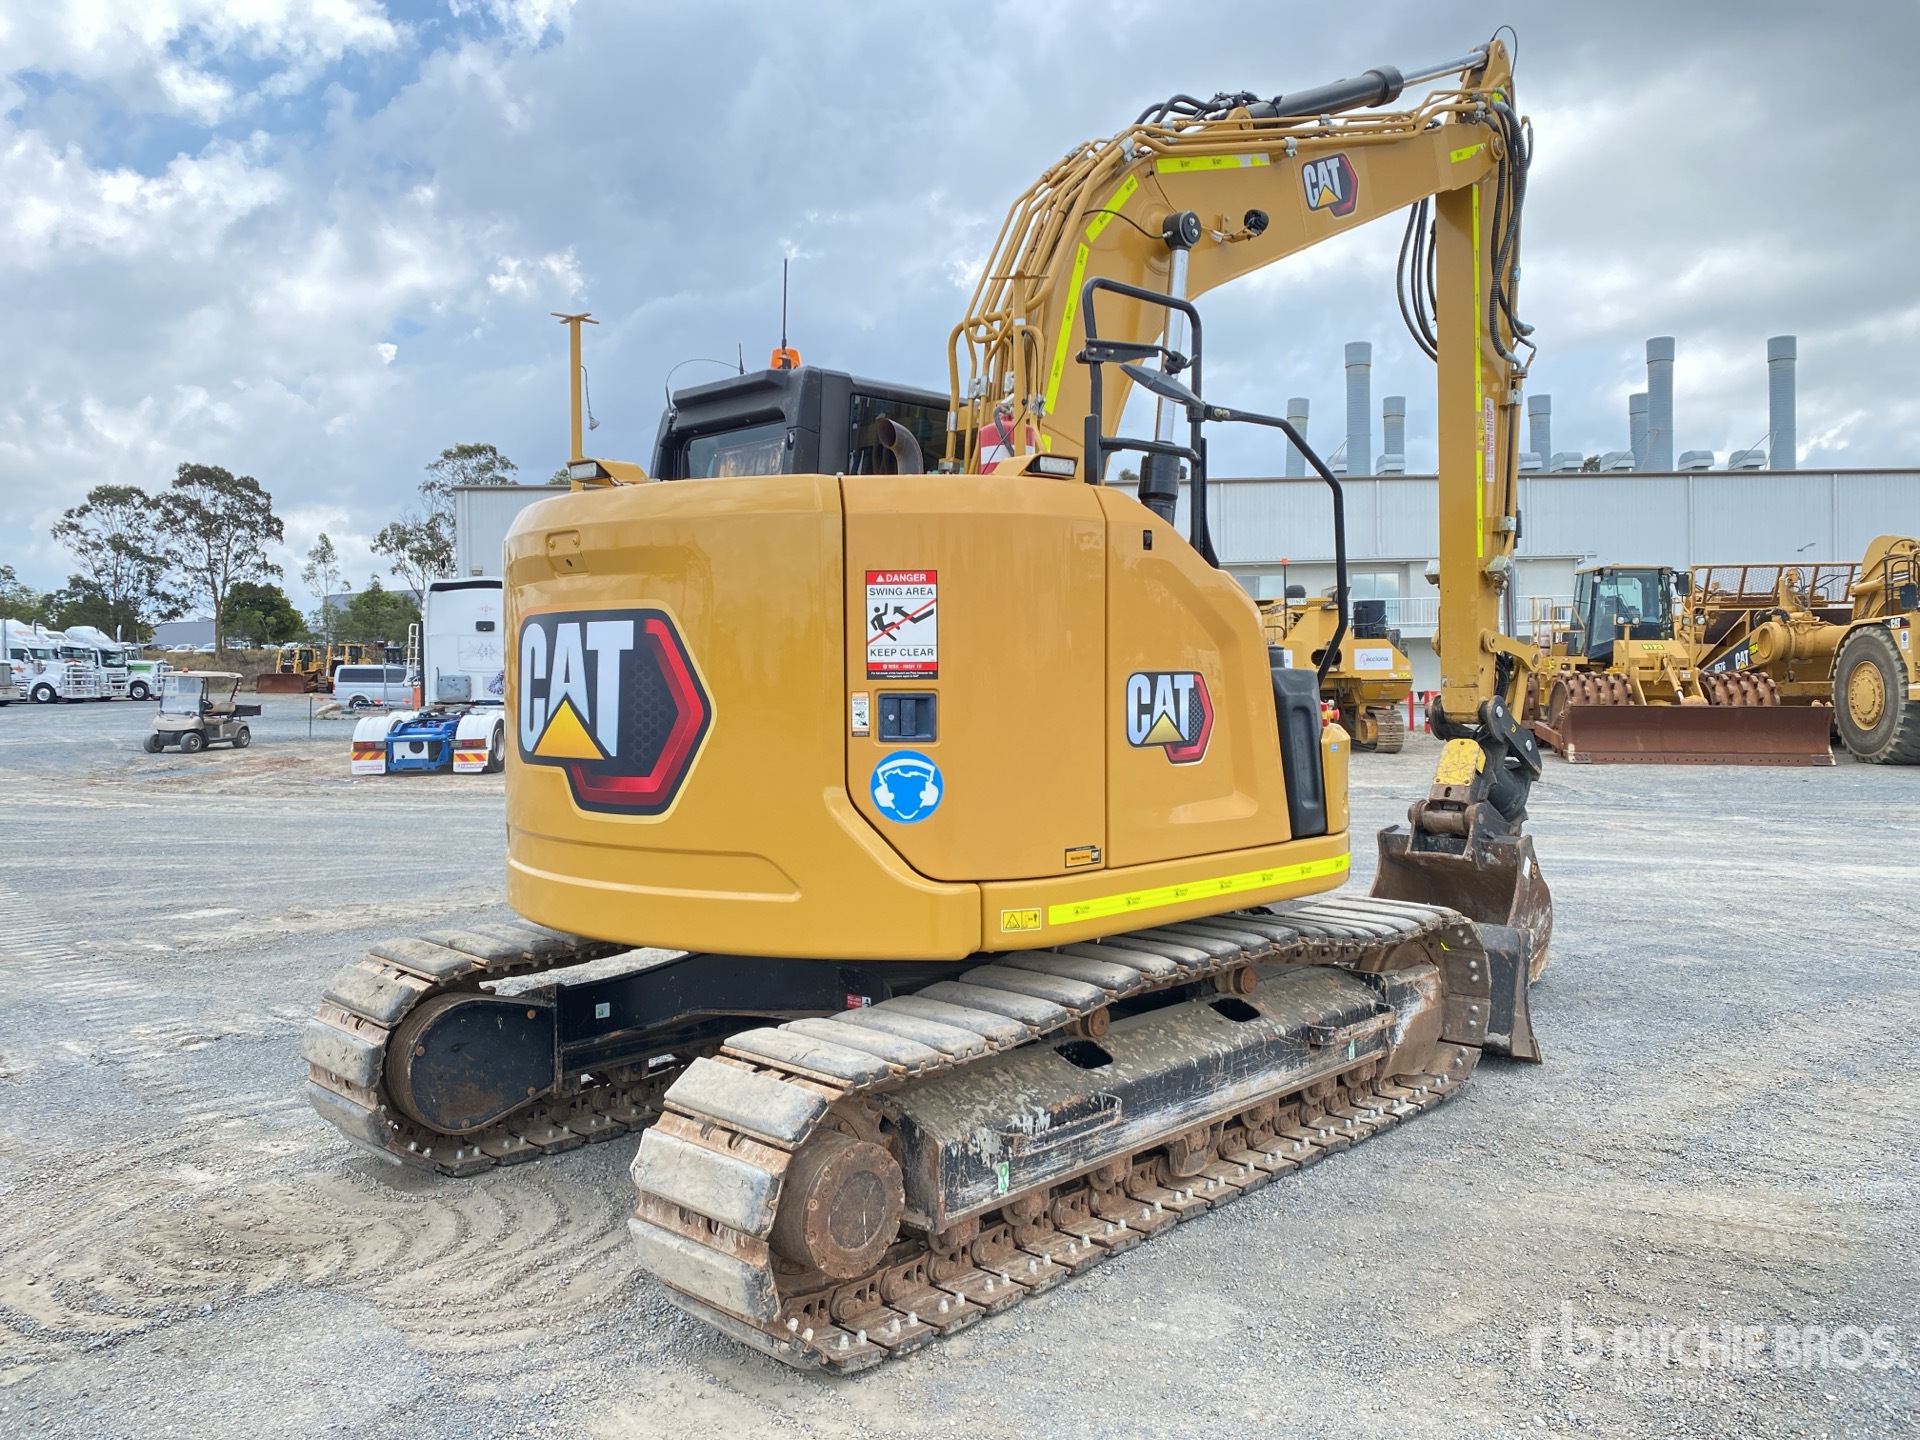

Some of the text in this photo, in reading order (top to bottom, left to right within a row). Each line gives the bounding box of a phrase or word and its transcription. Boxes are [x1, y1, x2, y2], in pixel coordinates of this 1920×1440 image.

[1303, 158, 1343, 208] CAT
[886, 573, 927, 582] DANGER
[869, 587, 934, 596] SWING AREA
[870, 648, 934, 657] KEEP CLEAR
[1735, 649, 1749, 670] CAT
[520, 620, 635, 757] CAT
[1127, 674, 1194, 745] CAT
